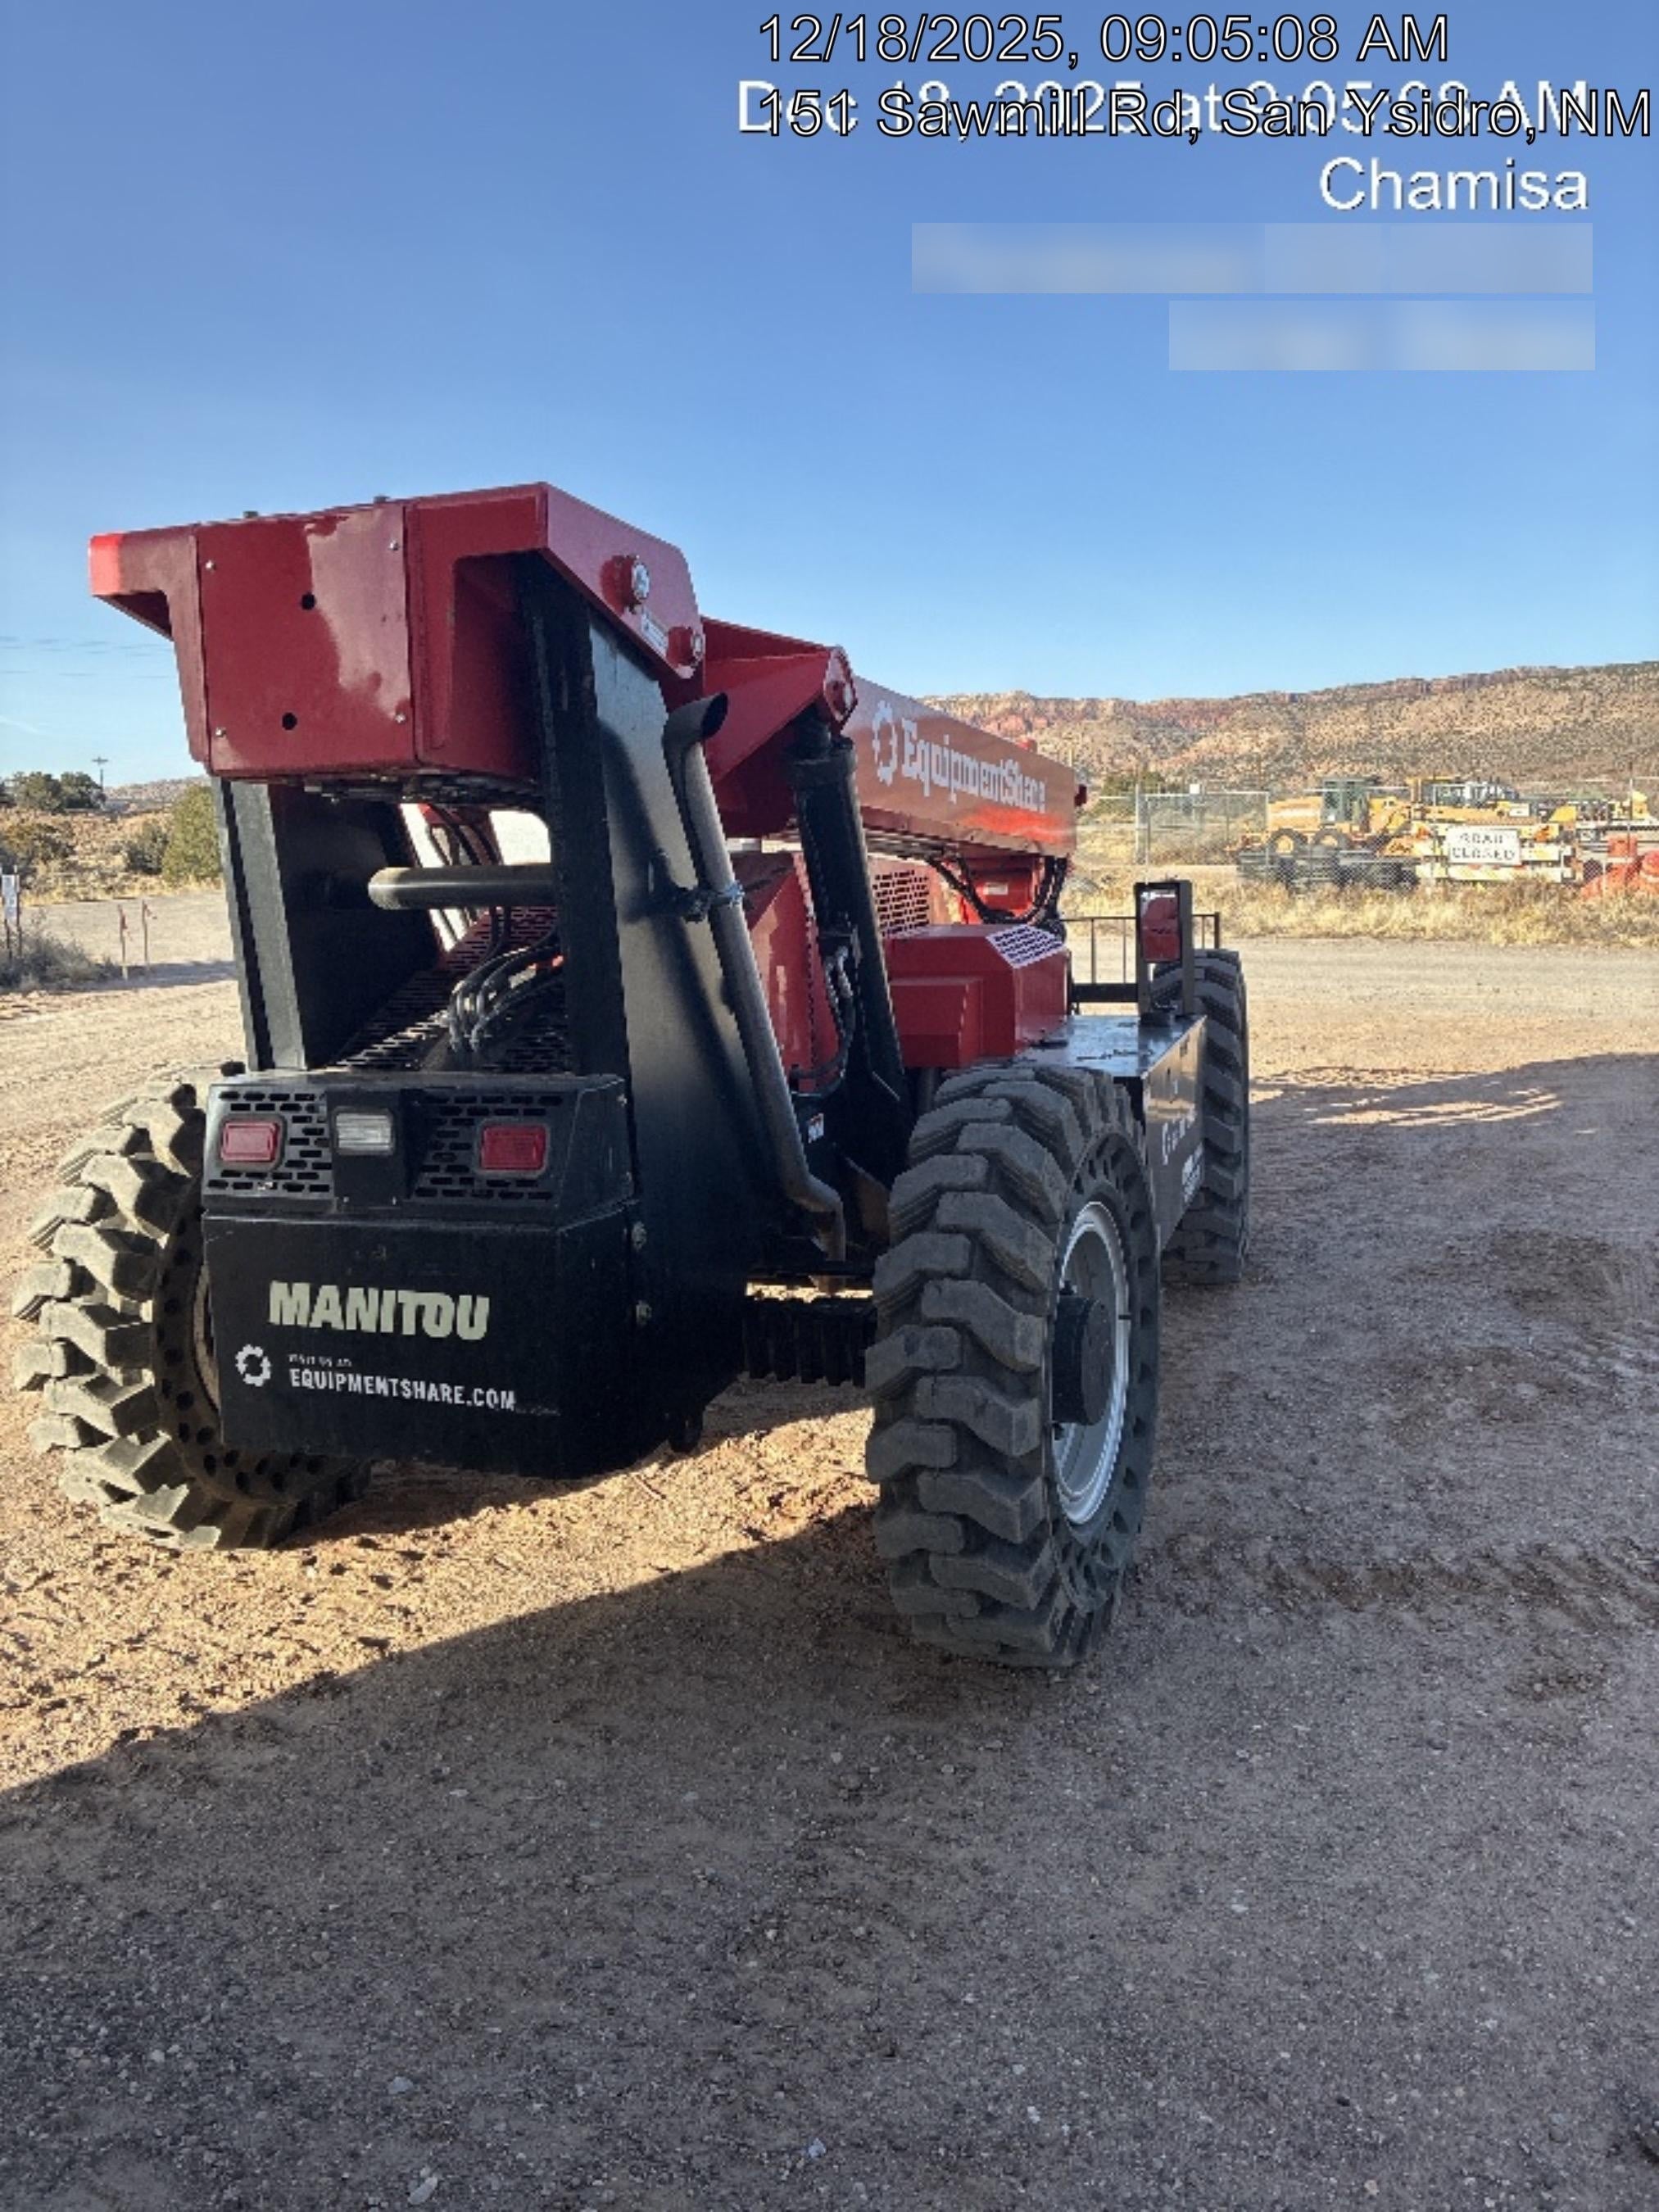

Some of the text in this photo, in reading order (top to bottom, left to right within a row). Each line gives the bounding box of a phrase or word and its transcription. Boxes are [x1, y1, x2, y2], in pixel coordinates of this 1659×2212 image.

[901, 716, 1046, 814] EquipmentShare
[267, 1280, 491, 1341] MANITOU
[288, 1367, 518, 1412] EQUIPMENTSHARE.COM
